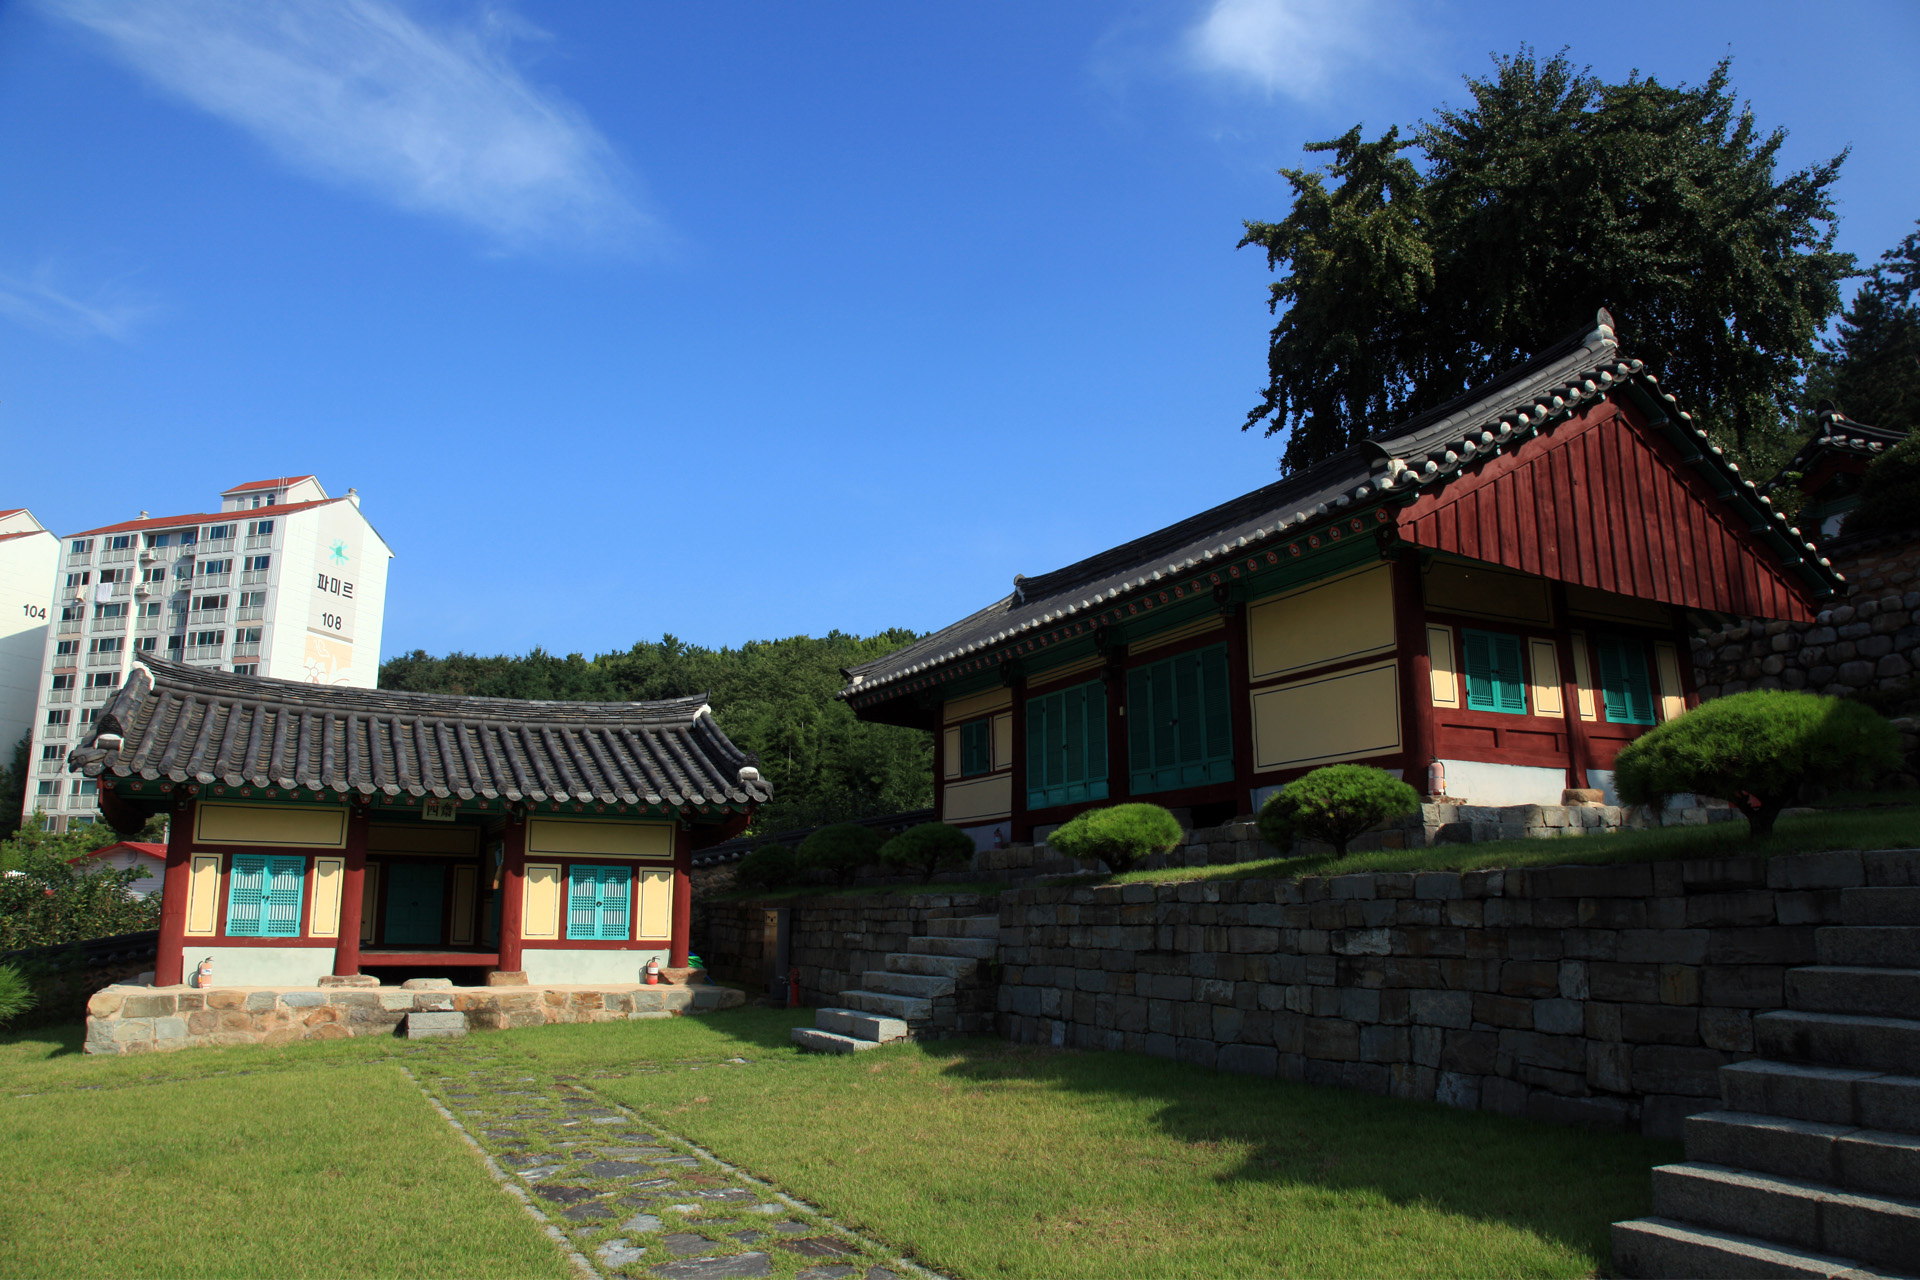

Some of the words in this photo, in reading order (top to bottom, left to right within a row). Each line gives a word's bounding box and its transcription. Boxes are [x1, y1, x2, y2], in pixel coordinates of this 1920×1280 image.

[317, 573, 354, 599] 파미르
[23, 604, 46, 620] 104
[322, 612, 342, 630] 108
